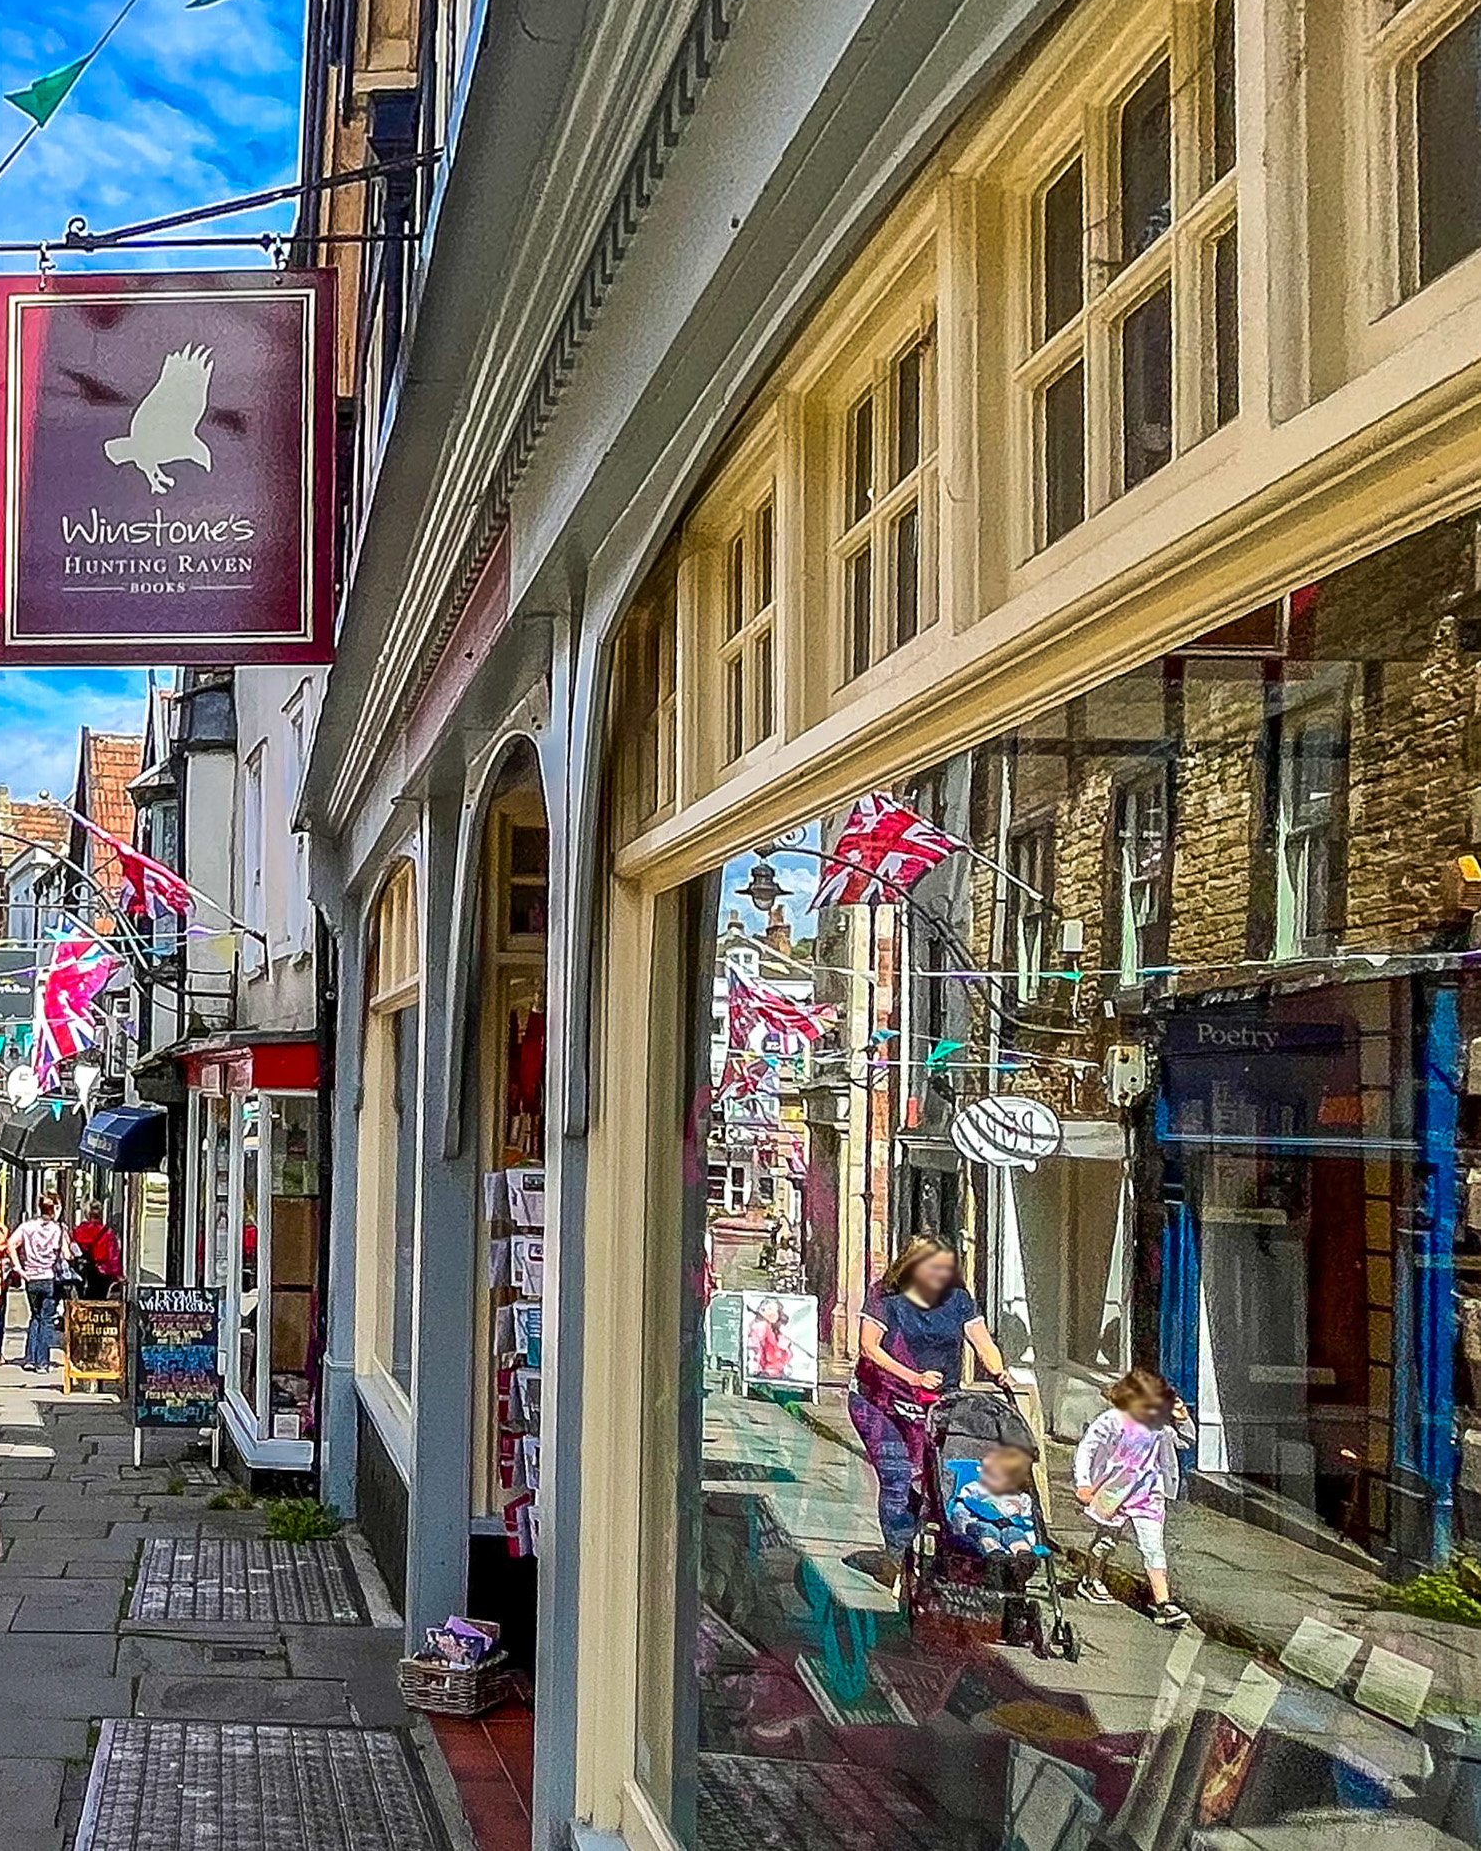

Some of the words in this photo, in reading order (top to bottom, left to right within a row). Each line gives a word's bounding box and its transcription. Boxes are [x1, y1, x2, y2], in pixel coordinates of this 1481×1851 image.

[62, 508, 255, 547] Winstone's
[64, 556, 167, 574] HUNTING
[178, 555, 253, 573] RAVEN
[130, 582, 186, 593] BOOKS
[1197, 1023, 1279, 1050] Poetry
